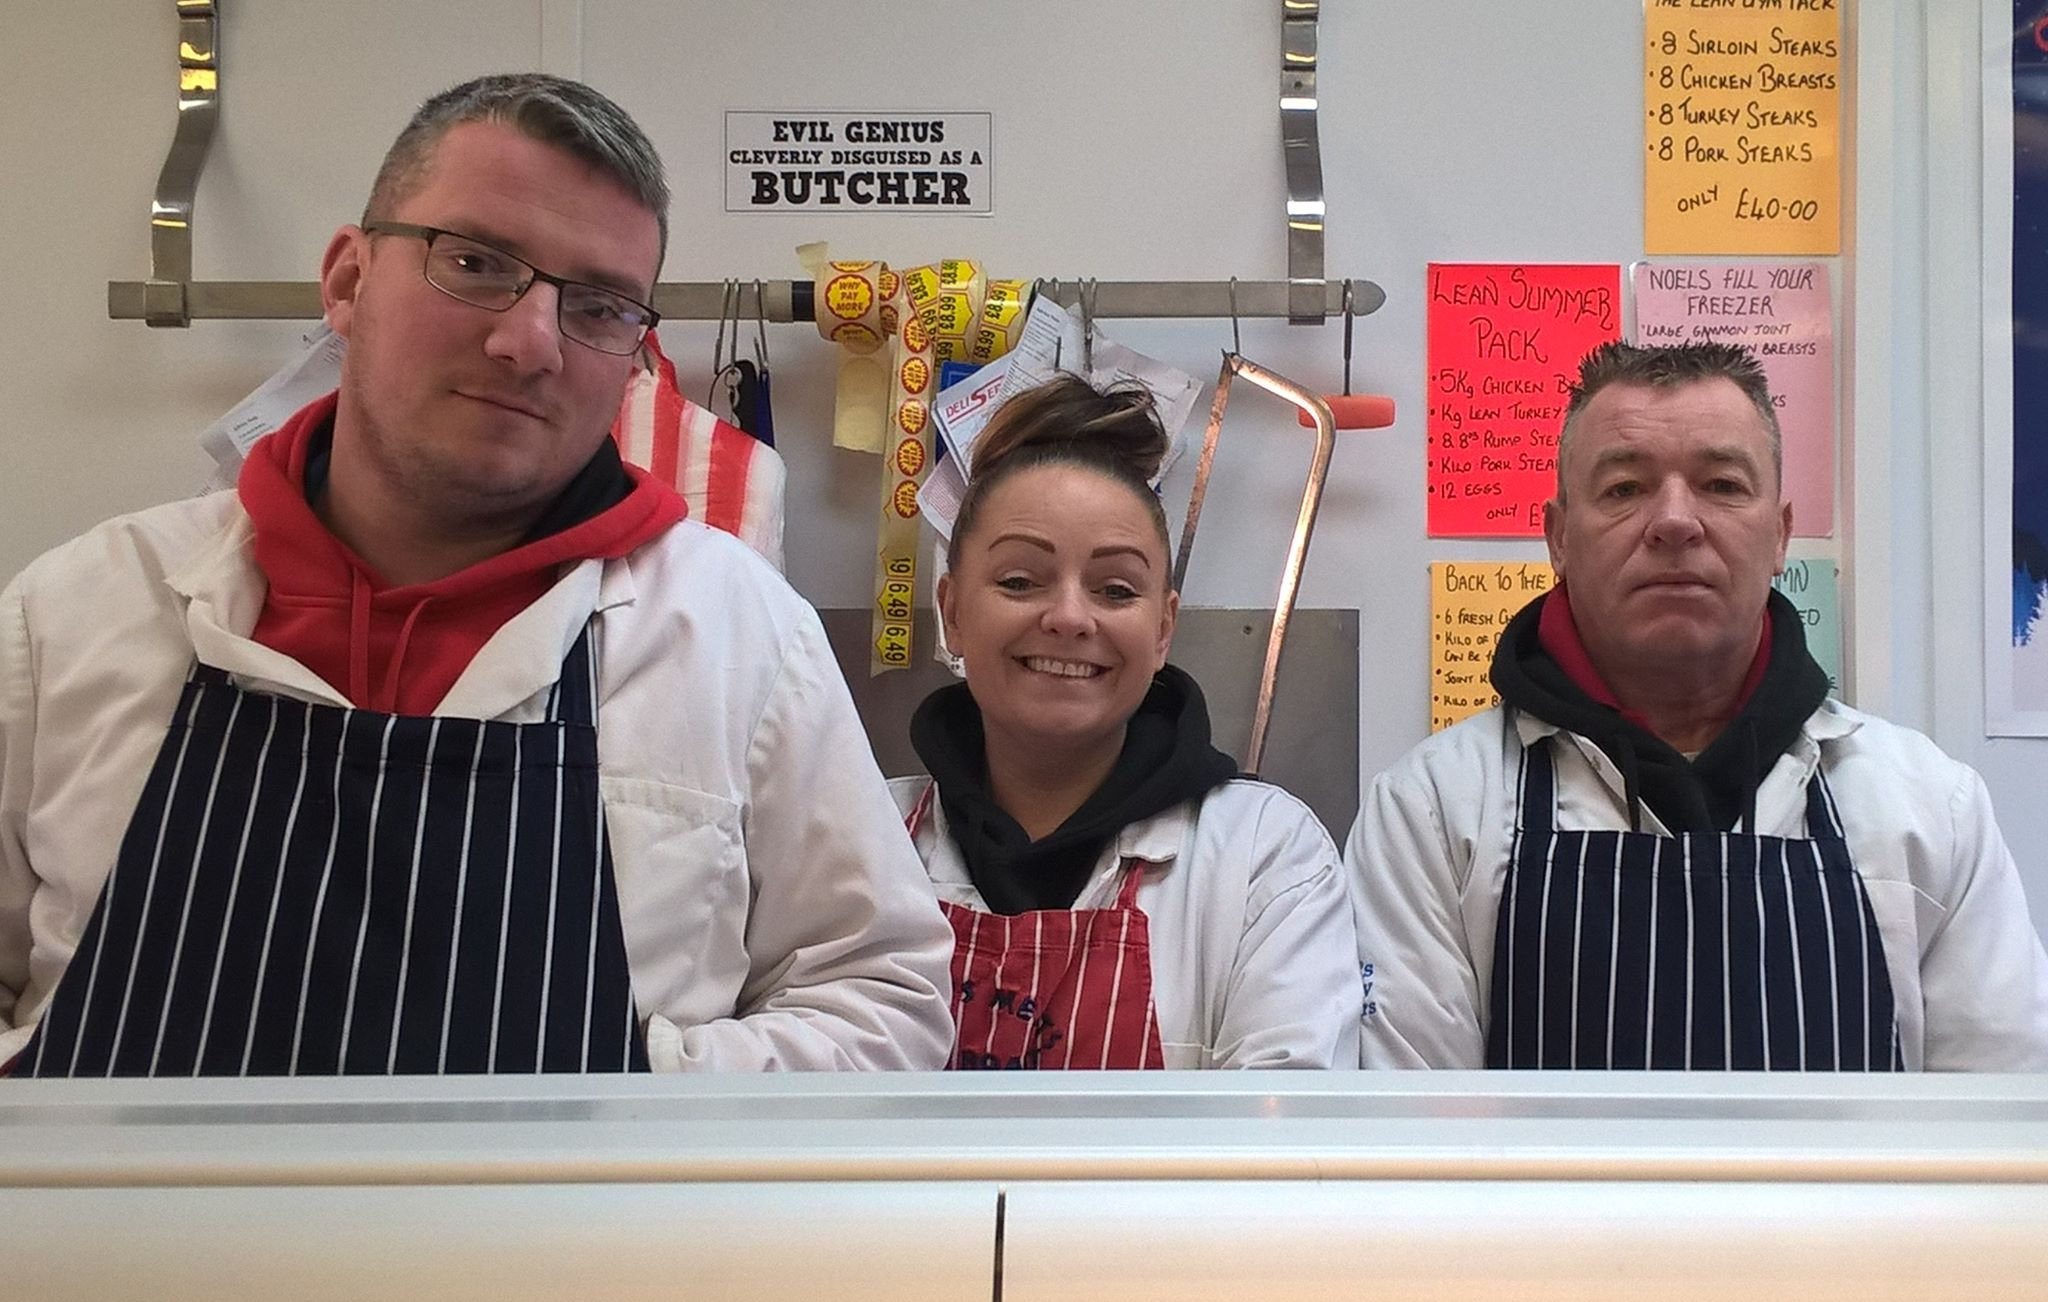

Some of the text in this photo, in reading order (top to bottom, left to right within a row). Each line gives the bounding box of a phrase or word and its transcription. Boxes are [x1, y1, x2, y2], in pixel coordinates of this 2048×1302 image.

[1662, 27, 1837, 58] 8 SIRLOIN STEAKS
[1660, 63, 1836, 93] 8 CHICKEN BREASTS
[1659, 96, 1818, 129] 8 TURKEY STEAKS
[773, 121, 944, 143] EVIL GENIUS
[729, 150, 983, 165] CLEVERLY DISGUISED AS A
[1659, 135, 1813, 164] 8 PORK STEAKS
[751, 171, 971, 205] BUTCHER
[1677, 184, 1718, 212] ONLY
[1650, 269, 1712, 290] NOELS
[1768, 269, 1813, 290] YOUR
[836, 302, 864, 312] MORE
[984, 289, 1008, 320] £8.99
[1434, 268, 1613, 331] LEAN SUMMER
[1687, 296, 1774, 317] FREEZER
[939, 296, 956, 330] £8.99
[1469, 317, 1549, 364] PACK
[1646, 323, 1793, 337] LARGE GAMMON JOINT
[974, 329, 996, 360] £8.99
[1762, 342, 1817, 356] BREASTS
[1482, 376, 1544, 396] CHICKEN
[1469, 407, 1500, 420] LEAN
[1507, 402, 1561, 420] TURKEY
[1483, 429, 1521, 448] RUMP
[1530, 429, 1561, 447] STEA
[1441, 453, 1557, 474] KILO PORK STEA
[1441, 482, 1502, 499] 12 EGGS
[1486, 504, 1517, 519] ONLY
[1446, 564, 1488, 592] BACK
[1494, 566, 1512, 591] TO
[1517, 564, 1546, 590] THE
[886, 583, 910, 618] 6.49
[1444, 609, 1452, 625] 6
[1458, 608, 1493, 625] FRESH
[884, 626, 907, 662] 6.49
[1445, 631, 1471, 646] KILO
[1476, 636, 1489, 645] OF
[1444, 650, 1464, 662] CAN
[1468, 651, 1481, 661] BE
[1444, 671, 1473, 684] JOINT
[1444, 696, 1468, 706] KILO
